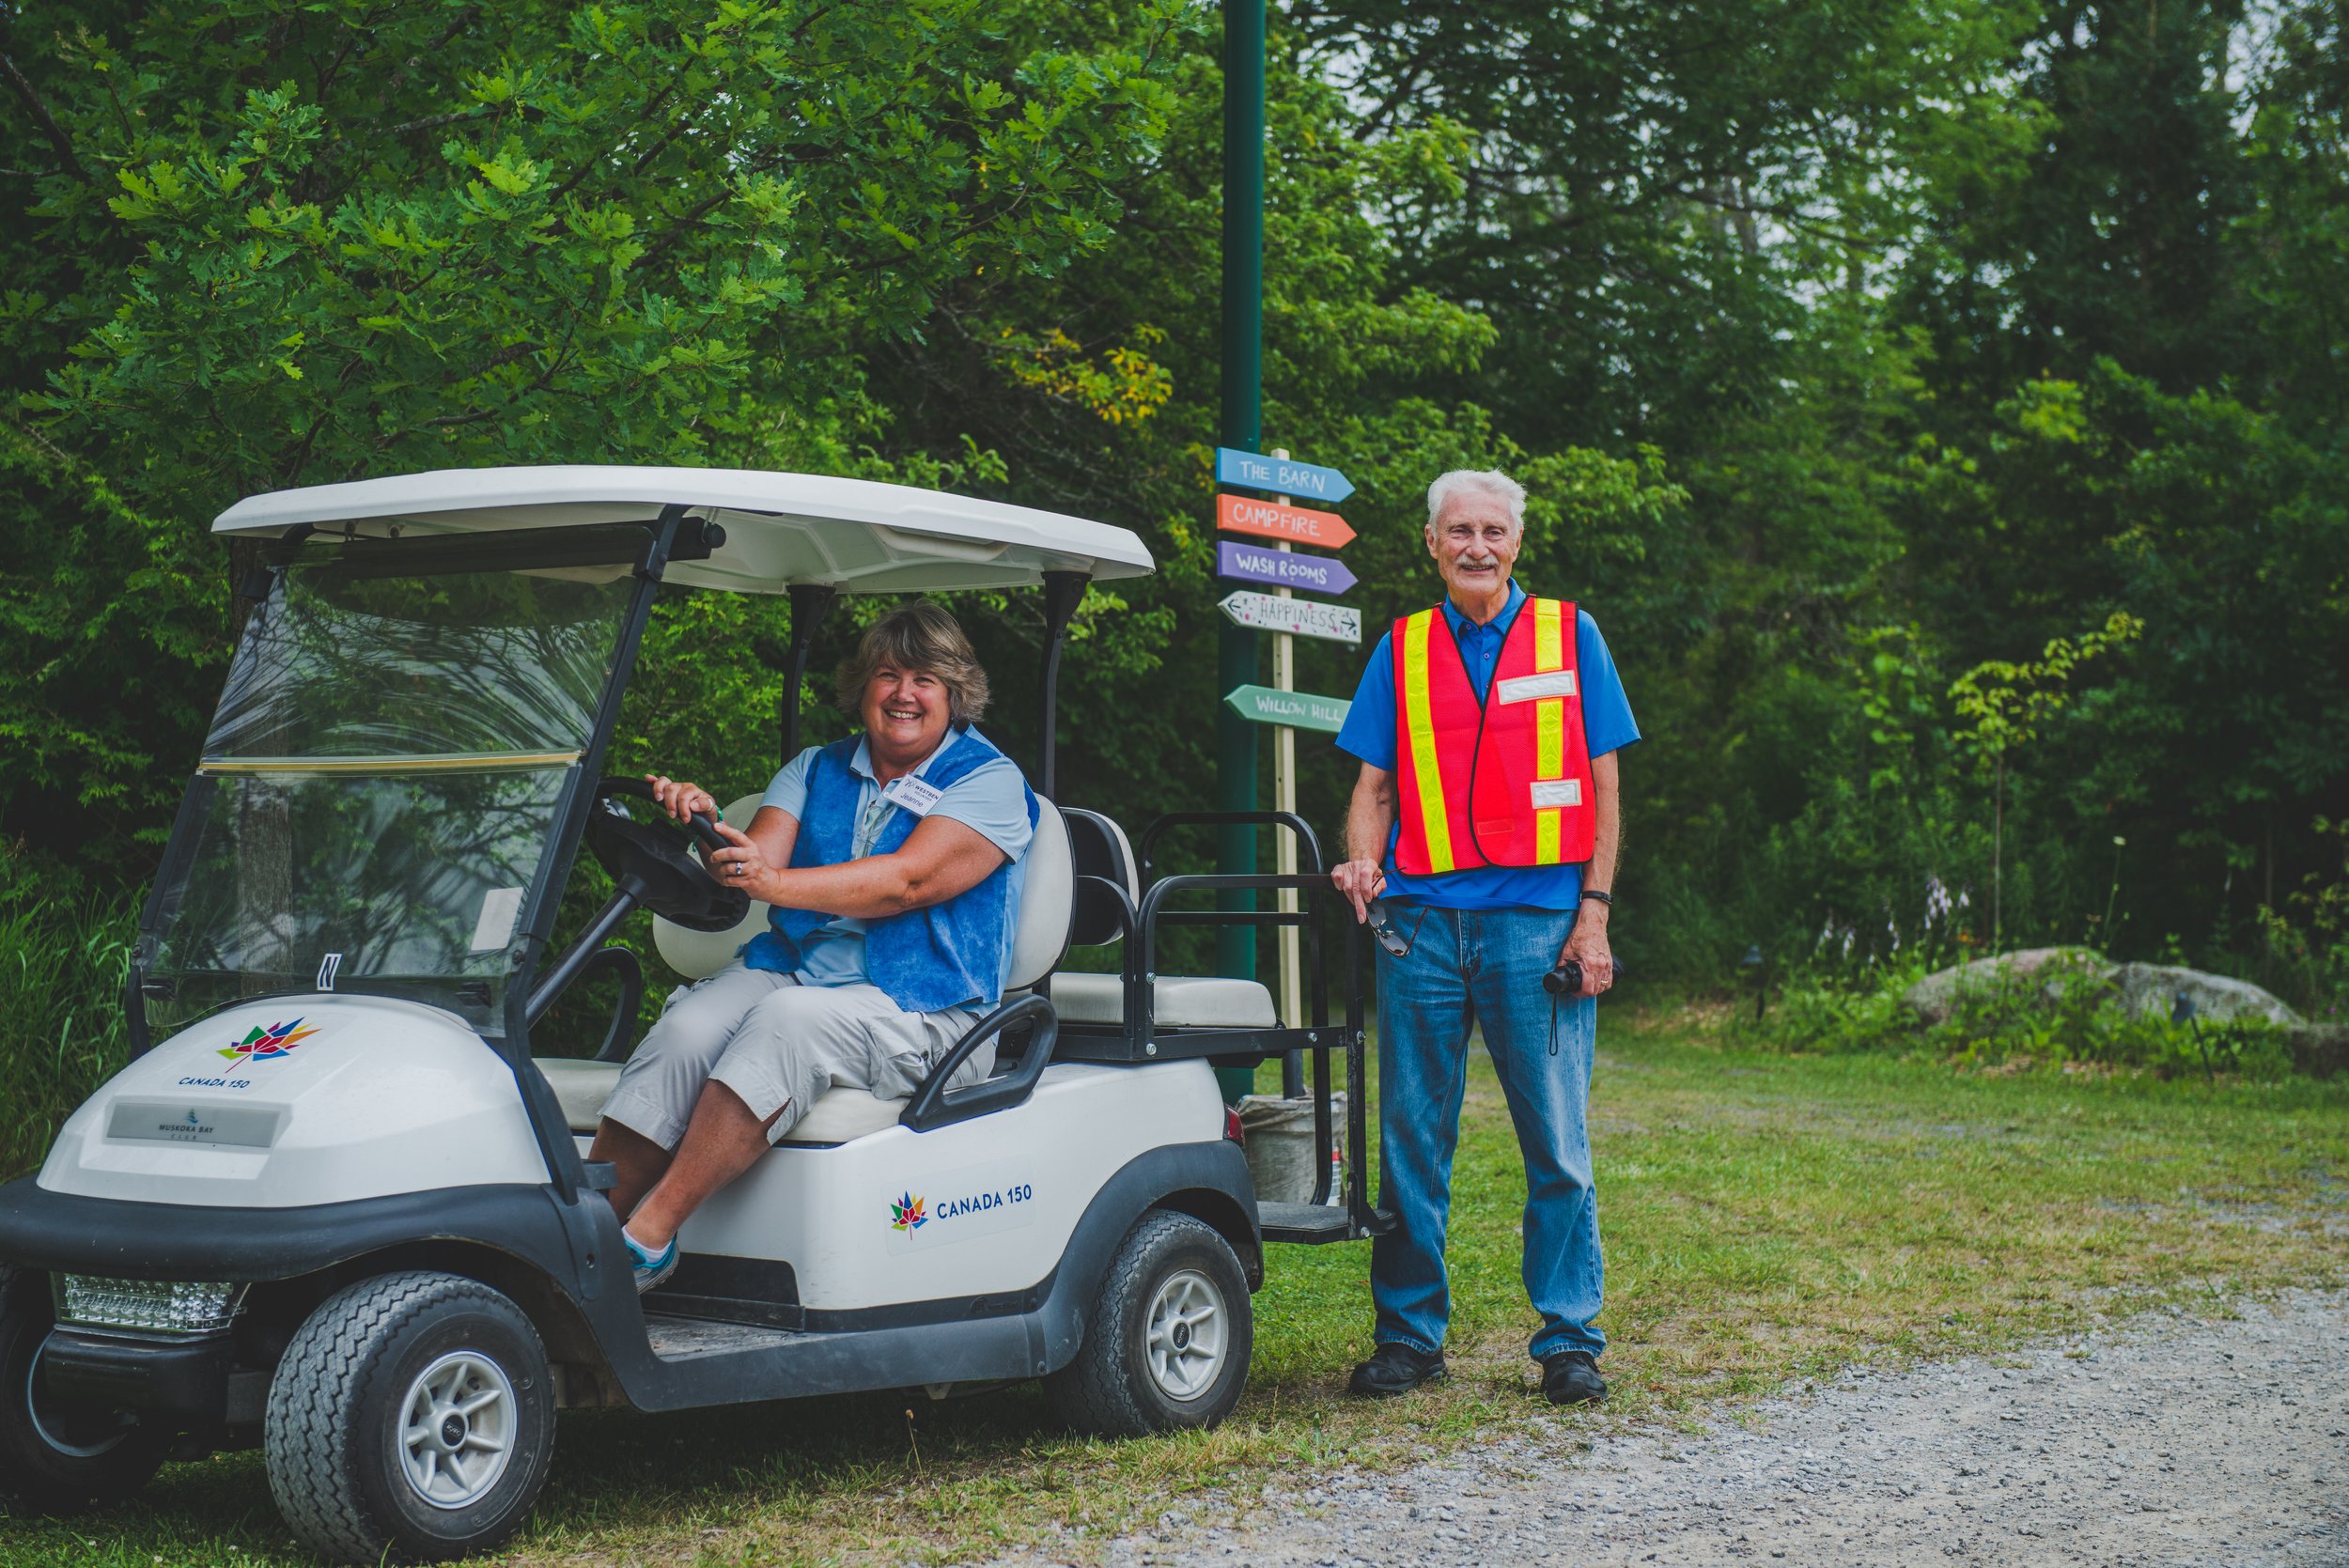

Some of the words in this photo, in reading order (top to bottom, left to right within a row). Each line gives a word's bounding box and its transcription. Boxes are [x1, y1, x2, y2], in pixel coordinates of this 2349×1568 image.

[1239, 459, 1270, 481] THE
[1278, 465, 1326, 493] BARN
[1232, 503, 1320, 536] CAMPFIRE
[1236, 552, 1275, 577] WASH
[1279, 559, 1328, 585] ROOMS
[1260, 602, 1336, 629] HAPPINESS
[1255, 695, 1306, 715] WILLOW
[1311, 704, 1342, 723] HILL
[900, 793, 923, 807] Jeanne
[915, 785, 939, 800] WESTBEN
[179, 1078, 226, 1087] CANADA
[937, 1191, 1003, 1219] CANADA
[1007, 1184, 1032, 1203] 150
